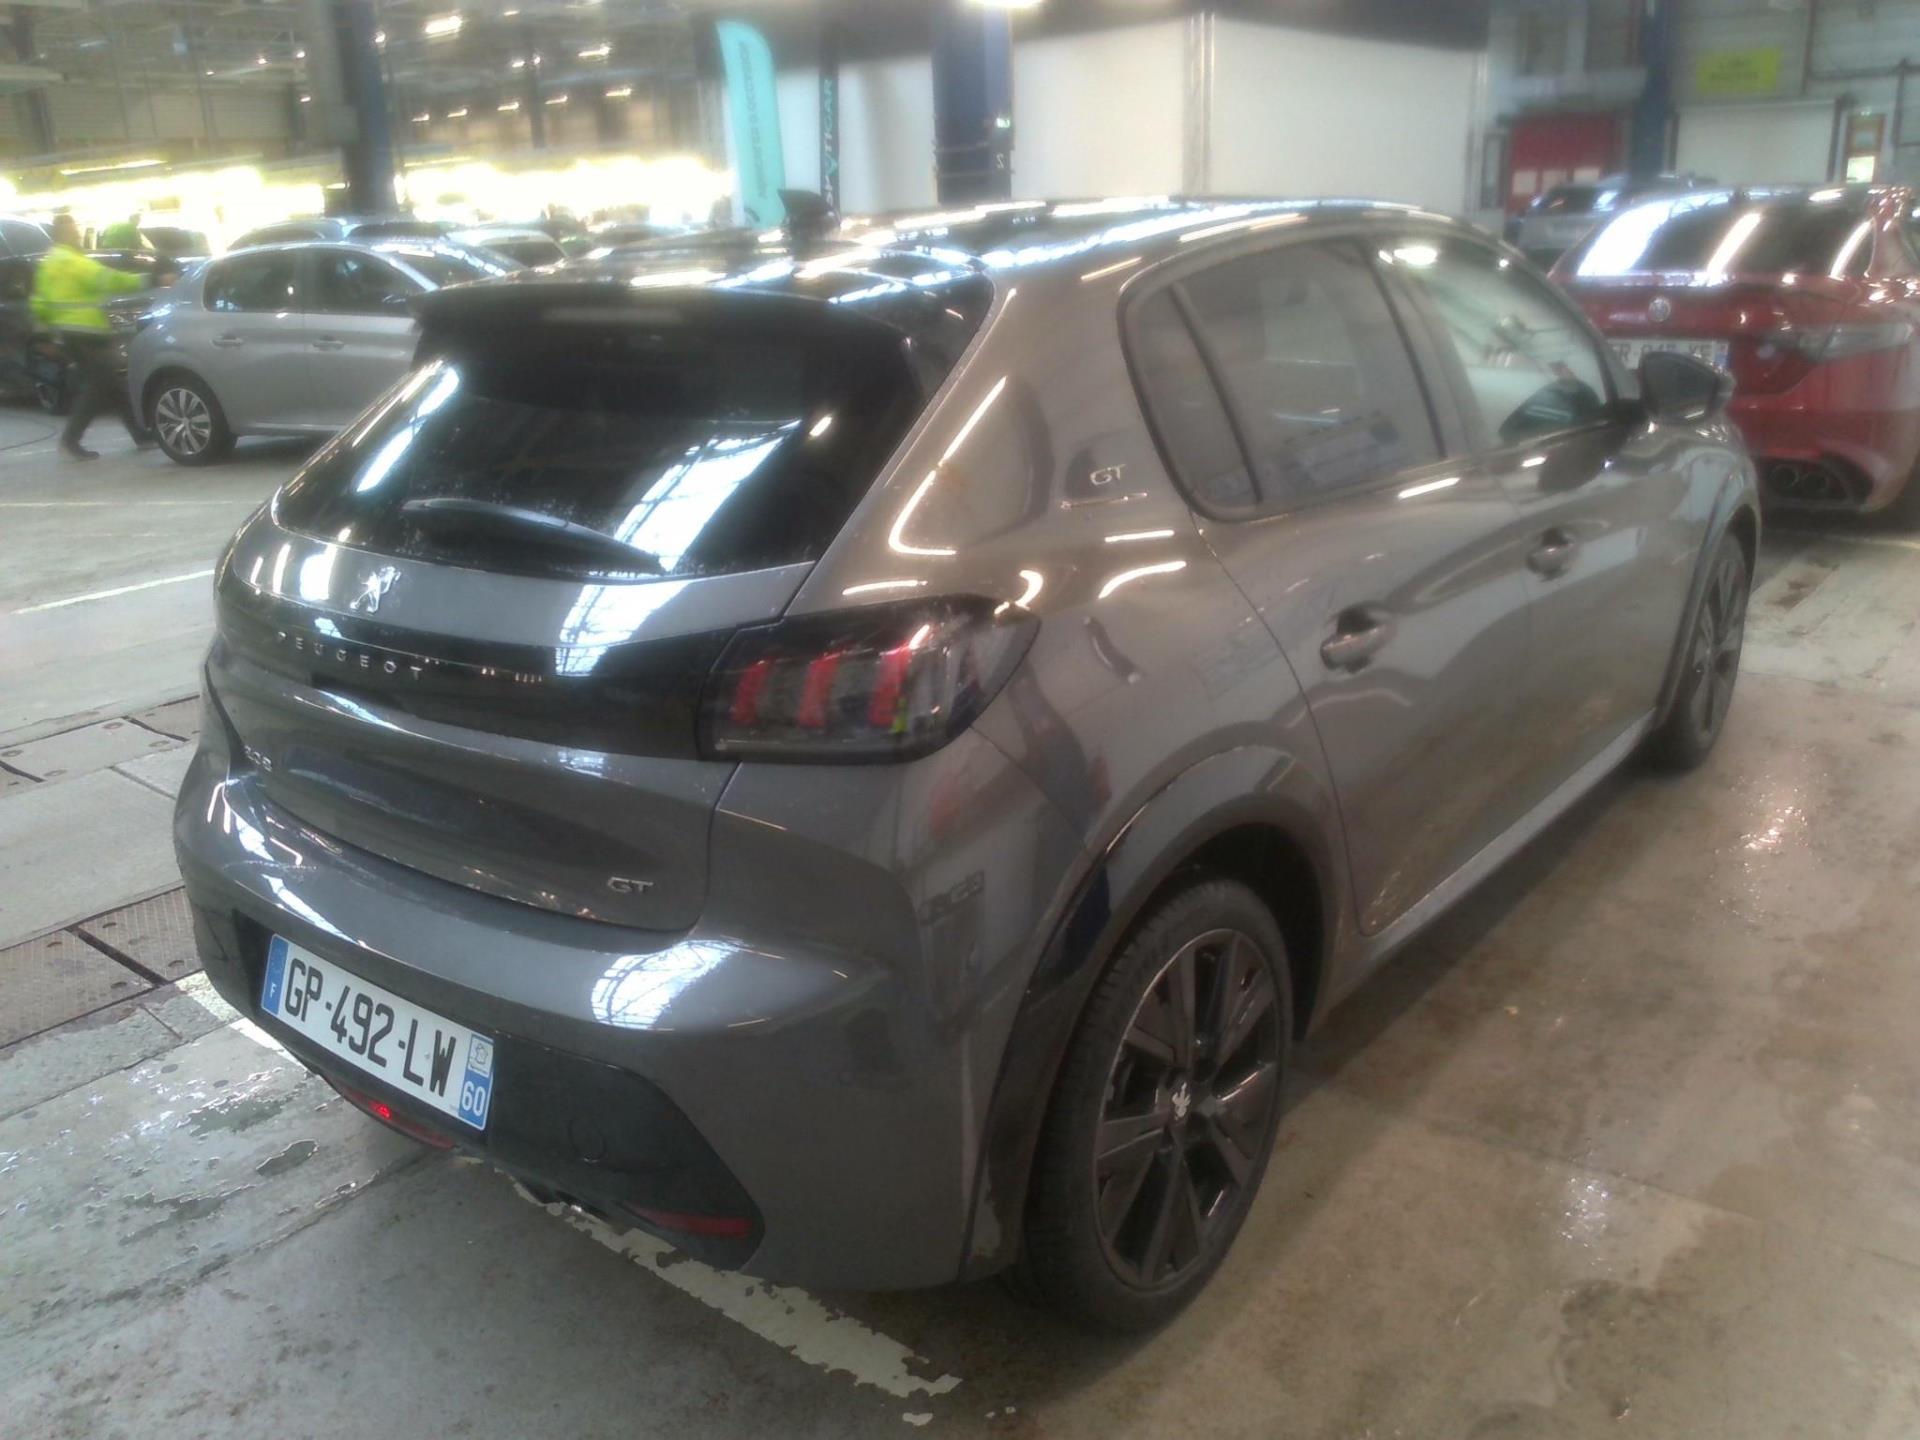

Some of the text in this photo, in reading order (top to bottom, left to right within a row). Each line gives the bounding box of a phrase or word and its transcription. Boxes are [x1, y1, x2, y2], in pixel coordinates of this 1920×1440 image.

[1090, 463, 1127, 486] GT
[277, 630, 423, 681] PEUGEOT
[607, 876, 654, 894] GT
[269, 982, 277, 998] F
[285, 957, 457, 1098] GP-492-LW
[461, 1080, 486, 1117] 60
